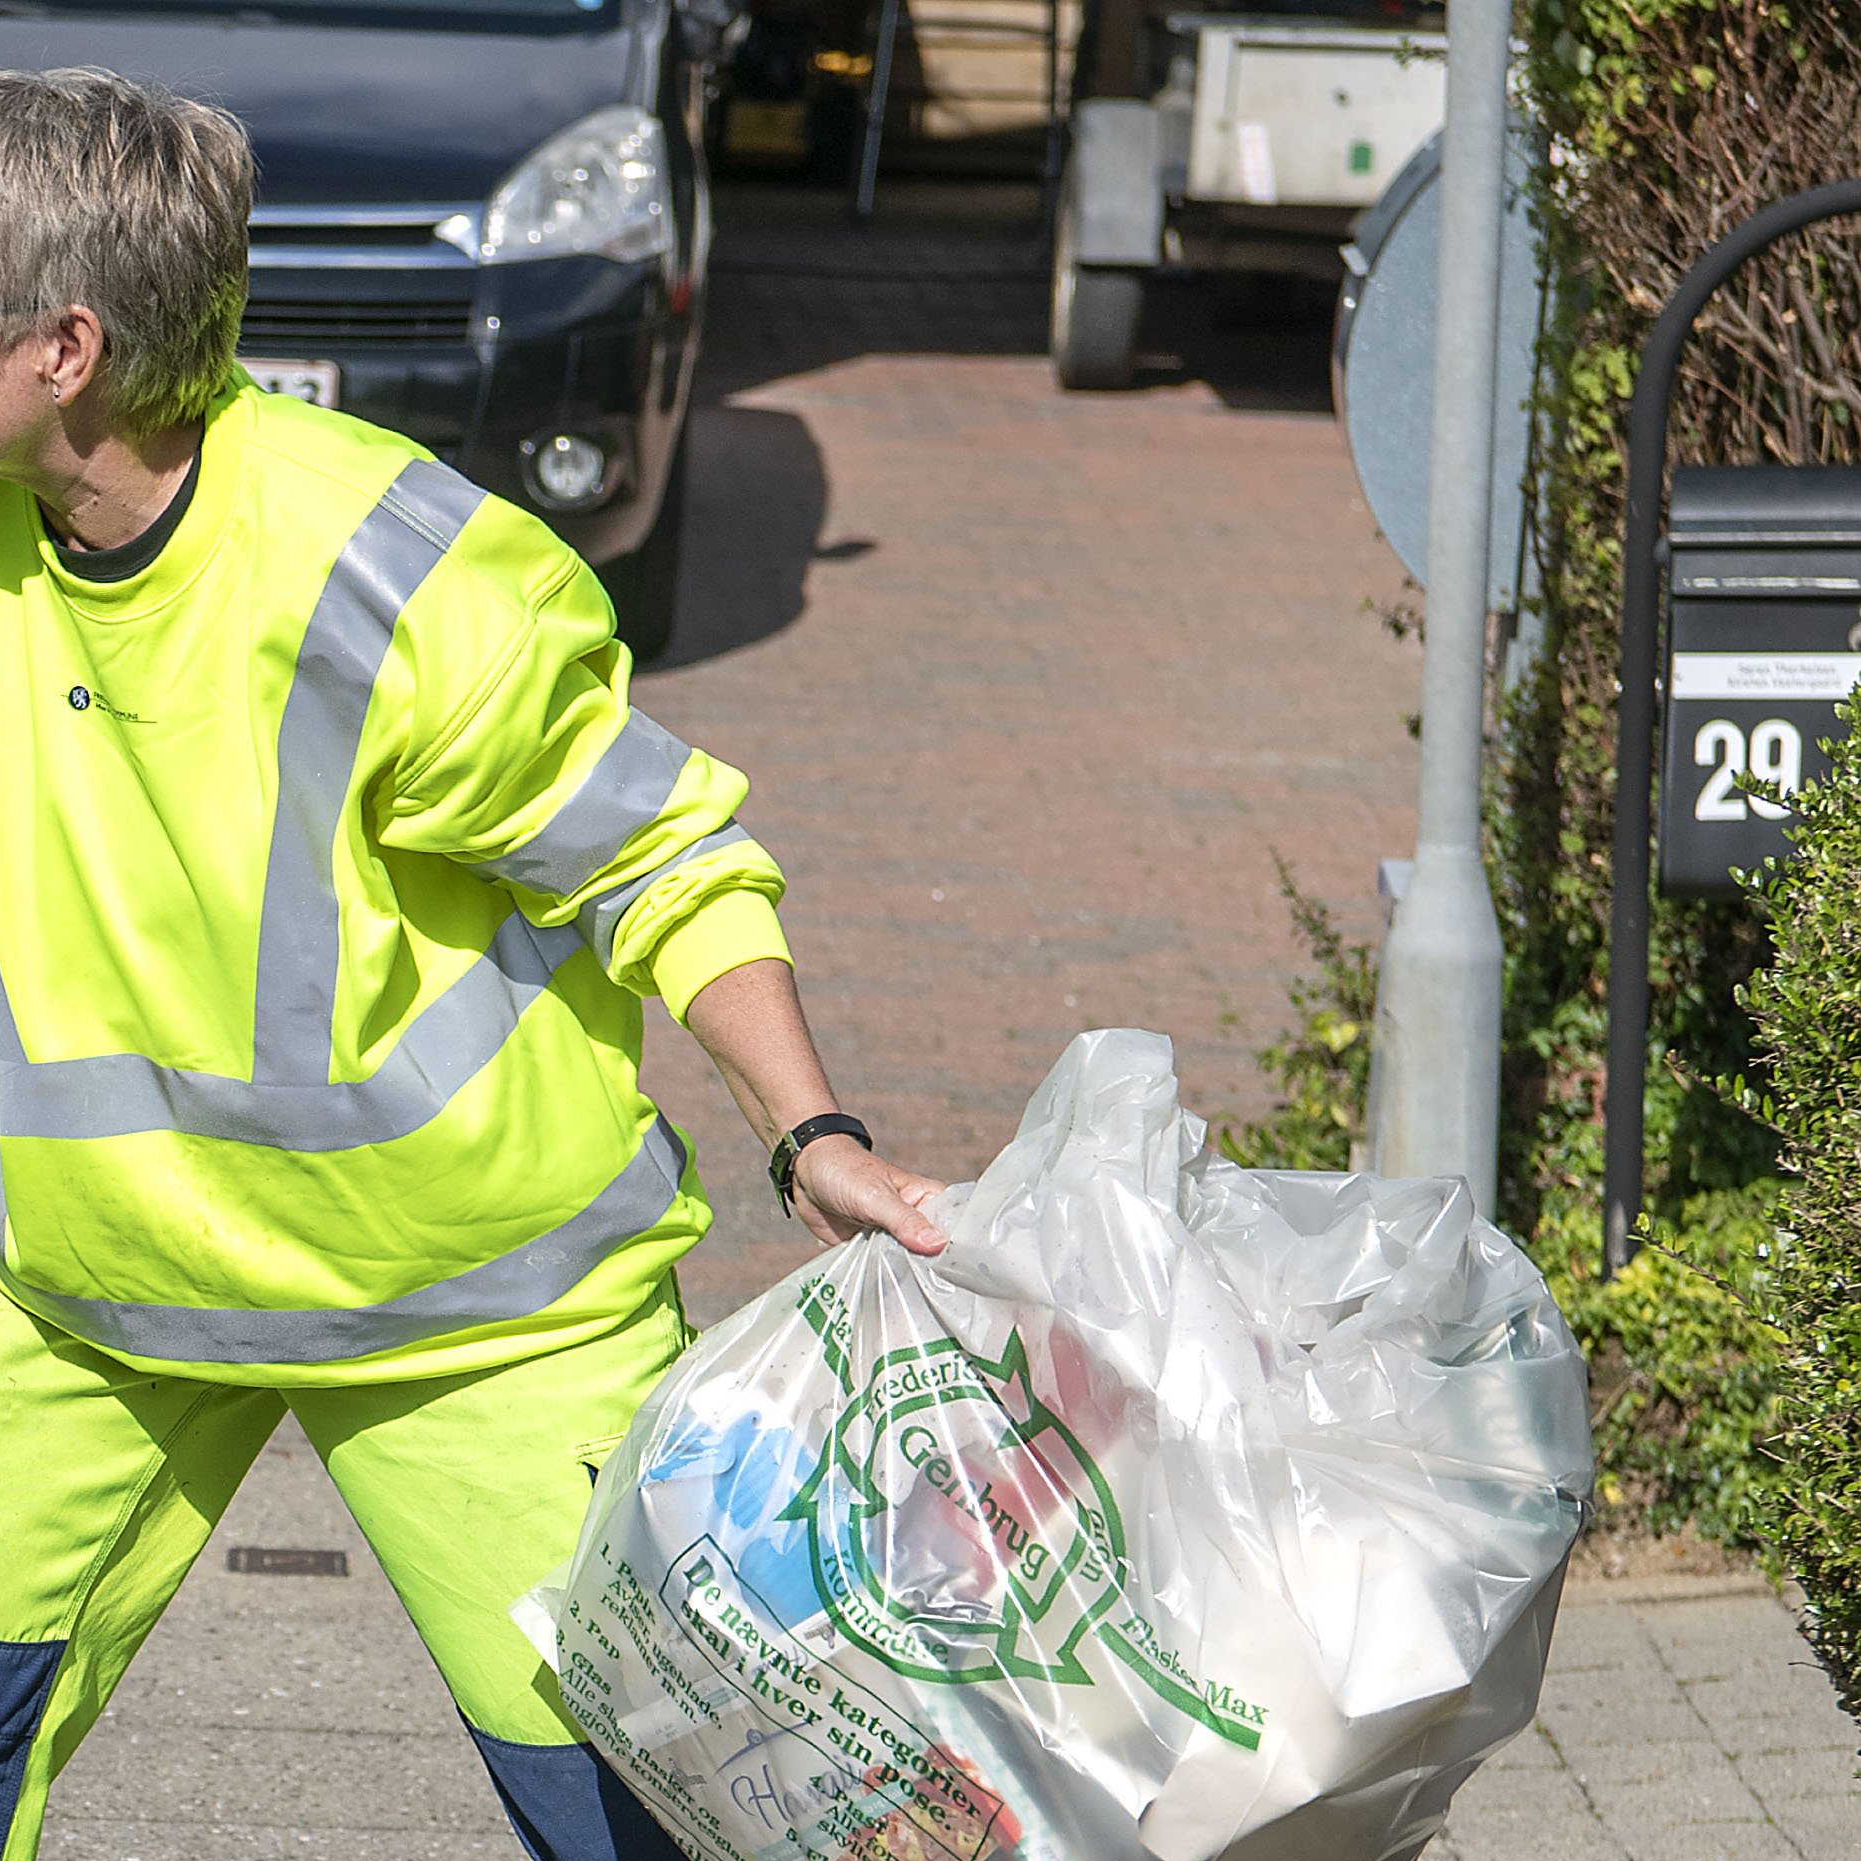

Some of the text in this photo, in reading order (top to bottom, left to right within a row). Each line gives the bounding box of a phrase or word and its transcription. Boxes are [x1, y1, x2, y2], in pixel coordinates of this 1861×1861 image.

[1694, 719, 1802, 820] 29
[899, 1425, 1050, 1581] Genbrug
[599, 1541, 612, 1565] 1.
[569, 1600, 621, 1662] 2. Pap
[571, 1652, 613, 1696] Glas
[652, 1641, 723, 1729] ugeblade,
[661, 1677, 699, 1724] m.m.
[683, 1554, 721, 1605] De
[718, 1603, 822, 1696] nævnte
[828, 1686, 982, 1818] kategorier
[680, 1599, 728, 1661] skal
[733, 1656, 748, 1676] i
[751, 1669, 823, 1726] hver
[827, 1724, 874, 1766] sin
[876, 1763, 952, 1831] pose.
[1203, 1680, 1270, 1726] Max
[560, 1668, 596, 1703] Alle
[597, 1702, 633, 1750] slags
[636, 1748, 695, 1805] flasker
[698, 1806, 721, 1831] og
[786, 1827, 803, 1849] 5.
[824, 1805, 863, 1838] Alle
[829, 1787, 889, 1836] Plast
